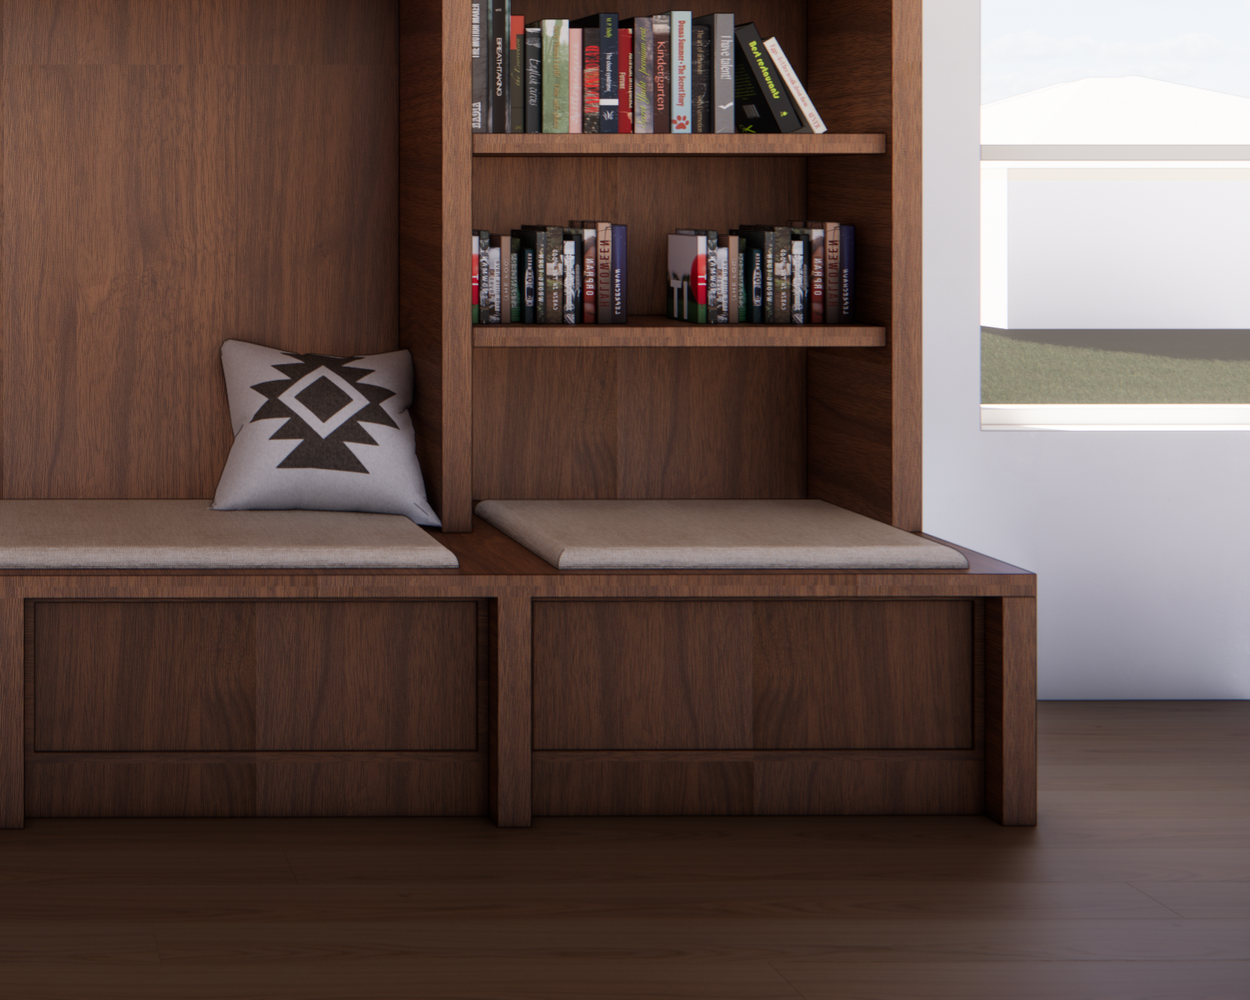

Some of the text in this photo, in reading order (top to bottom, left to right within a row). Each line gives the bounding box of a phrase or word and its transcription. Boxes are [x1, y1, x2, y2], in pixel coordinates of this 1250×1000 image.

[721, 40, 732, 56] have
[526, 59, 539, 105] English circus
[656, 41, 666, 110] Kindergarten
[720, 58, 733, 80] talent!
[749, 41, 780, 99] Best restaurants
[677, 93, 685, 106] Story
